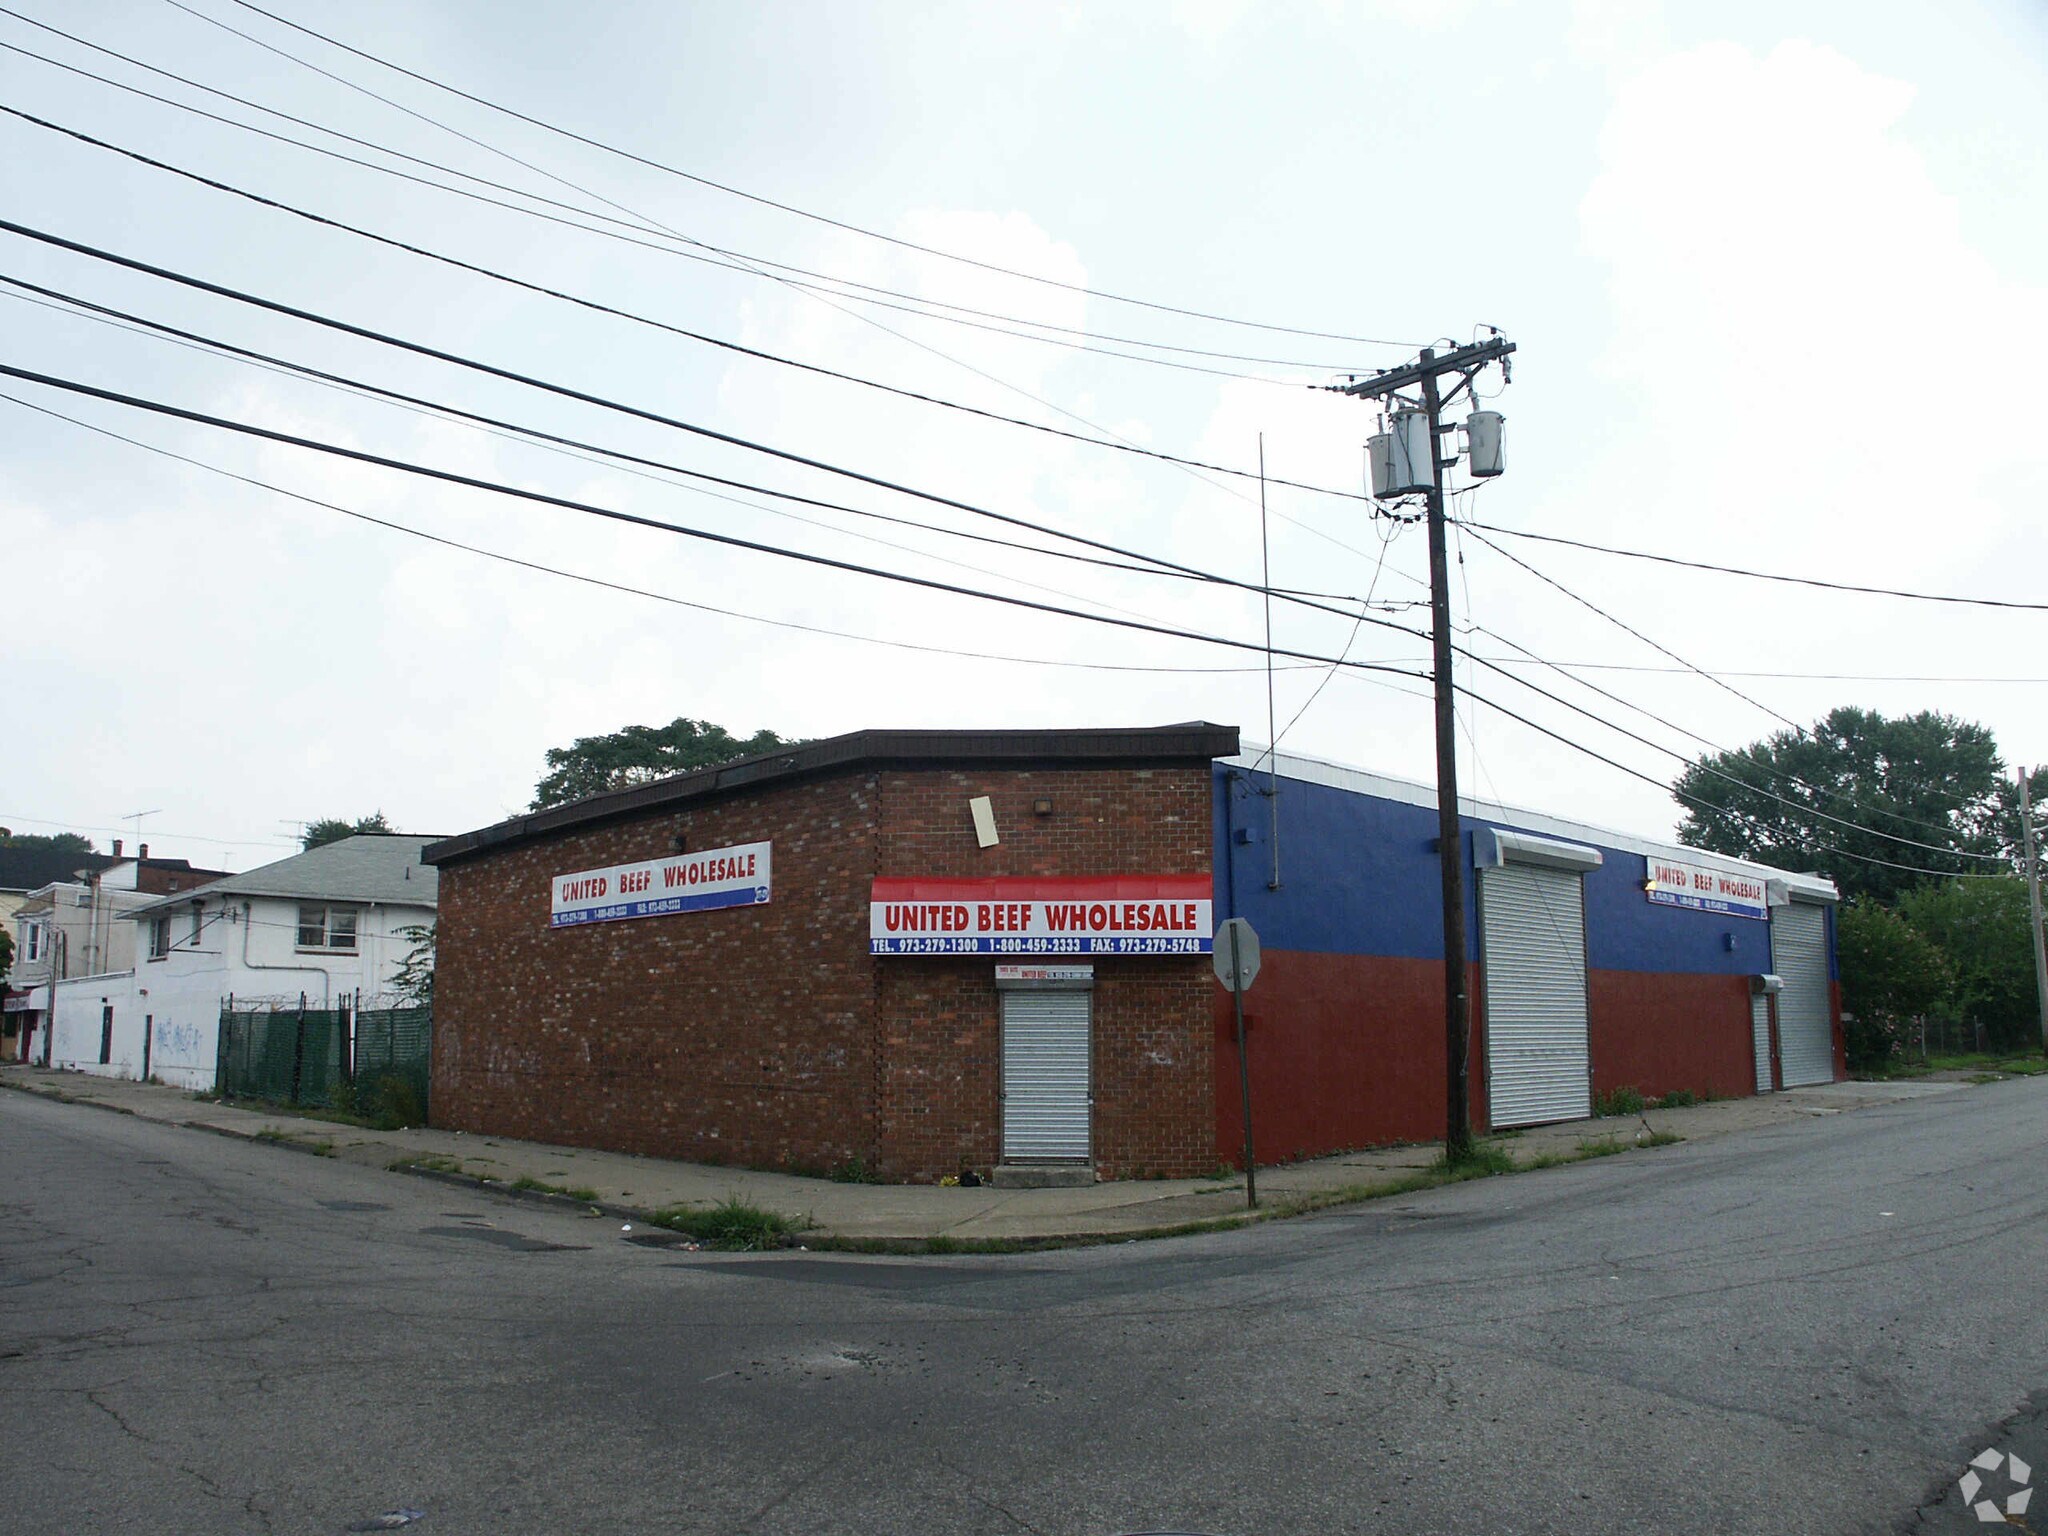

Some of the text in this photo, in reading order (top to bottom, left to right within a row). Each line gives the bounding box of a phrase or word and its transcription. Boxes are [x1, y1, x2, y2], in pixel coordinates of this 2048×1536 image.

[562, 854, 756, 902] UNITED BEEF WHOLESALE
[1655, 865, 1761, 900] UNITED BEEF WHOLESALE
[885, 904, 1197, 931] UNITED BEEF WHOLESALE
[872, 938, 1200, 952] TEL. 973-279-1300 1-800-459-2333 FAX: 973-279-5748
